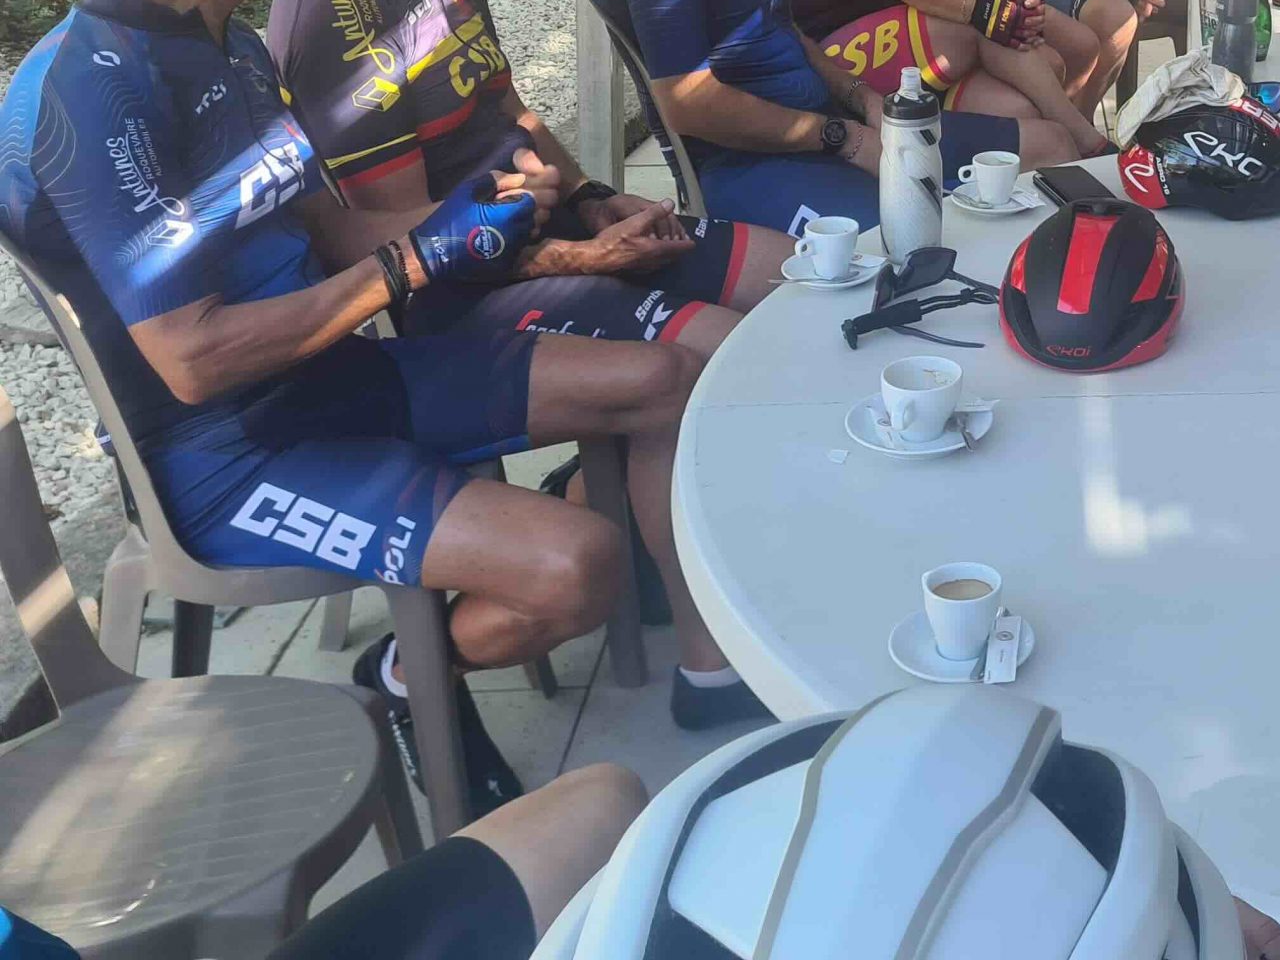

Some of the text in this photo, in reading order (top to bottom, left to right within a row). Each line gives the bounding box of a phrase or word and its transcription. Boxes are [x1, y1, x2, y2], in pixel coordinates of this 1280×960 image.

[449, 35, 505, 98] CSB
[824, 19, 900, 77] SB
[106, 136, 185, 215] Antunes
[125, 118, 153, 180] ROQUEVAIRE
[229, 482, 377, 570] CSB
[384, 516, 416, 585] POLI
